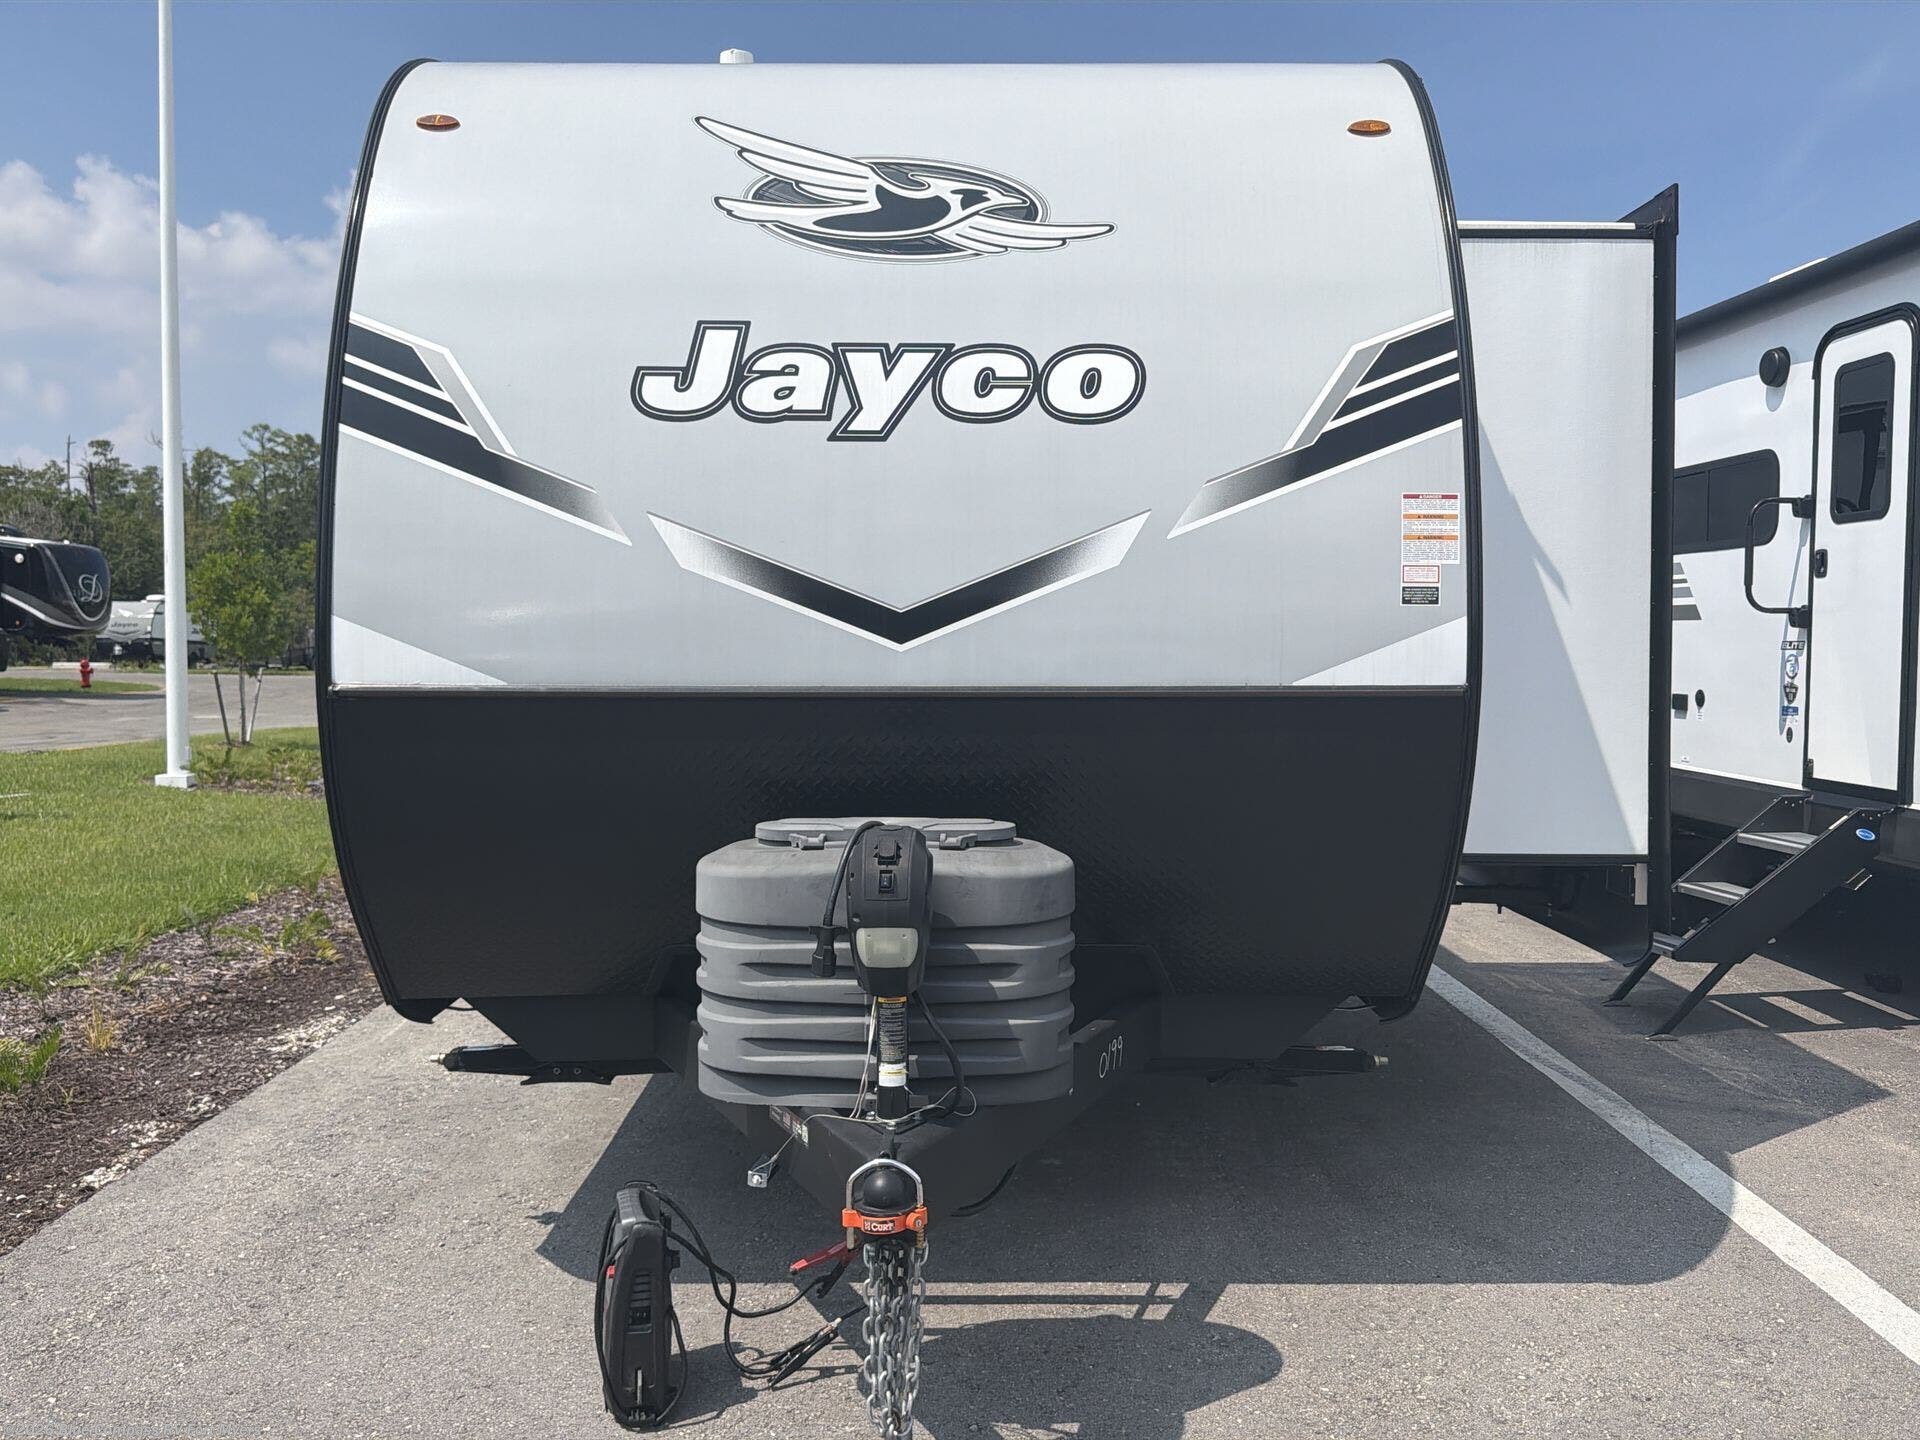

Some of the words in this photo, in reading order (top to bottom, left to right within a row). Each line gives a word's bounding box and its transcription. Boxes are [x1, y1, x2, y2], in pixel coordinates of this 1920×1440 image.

[630, 319, 1147, 442] Jayco
[1781, 641, 1805, 650] ELITE
[1099, 1035, 1124, 1078] 0199
